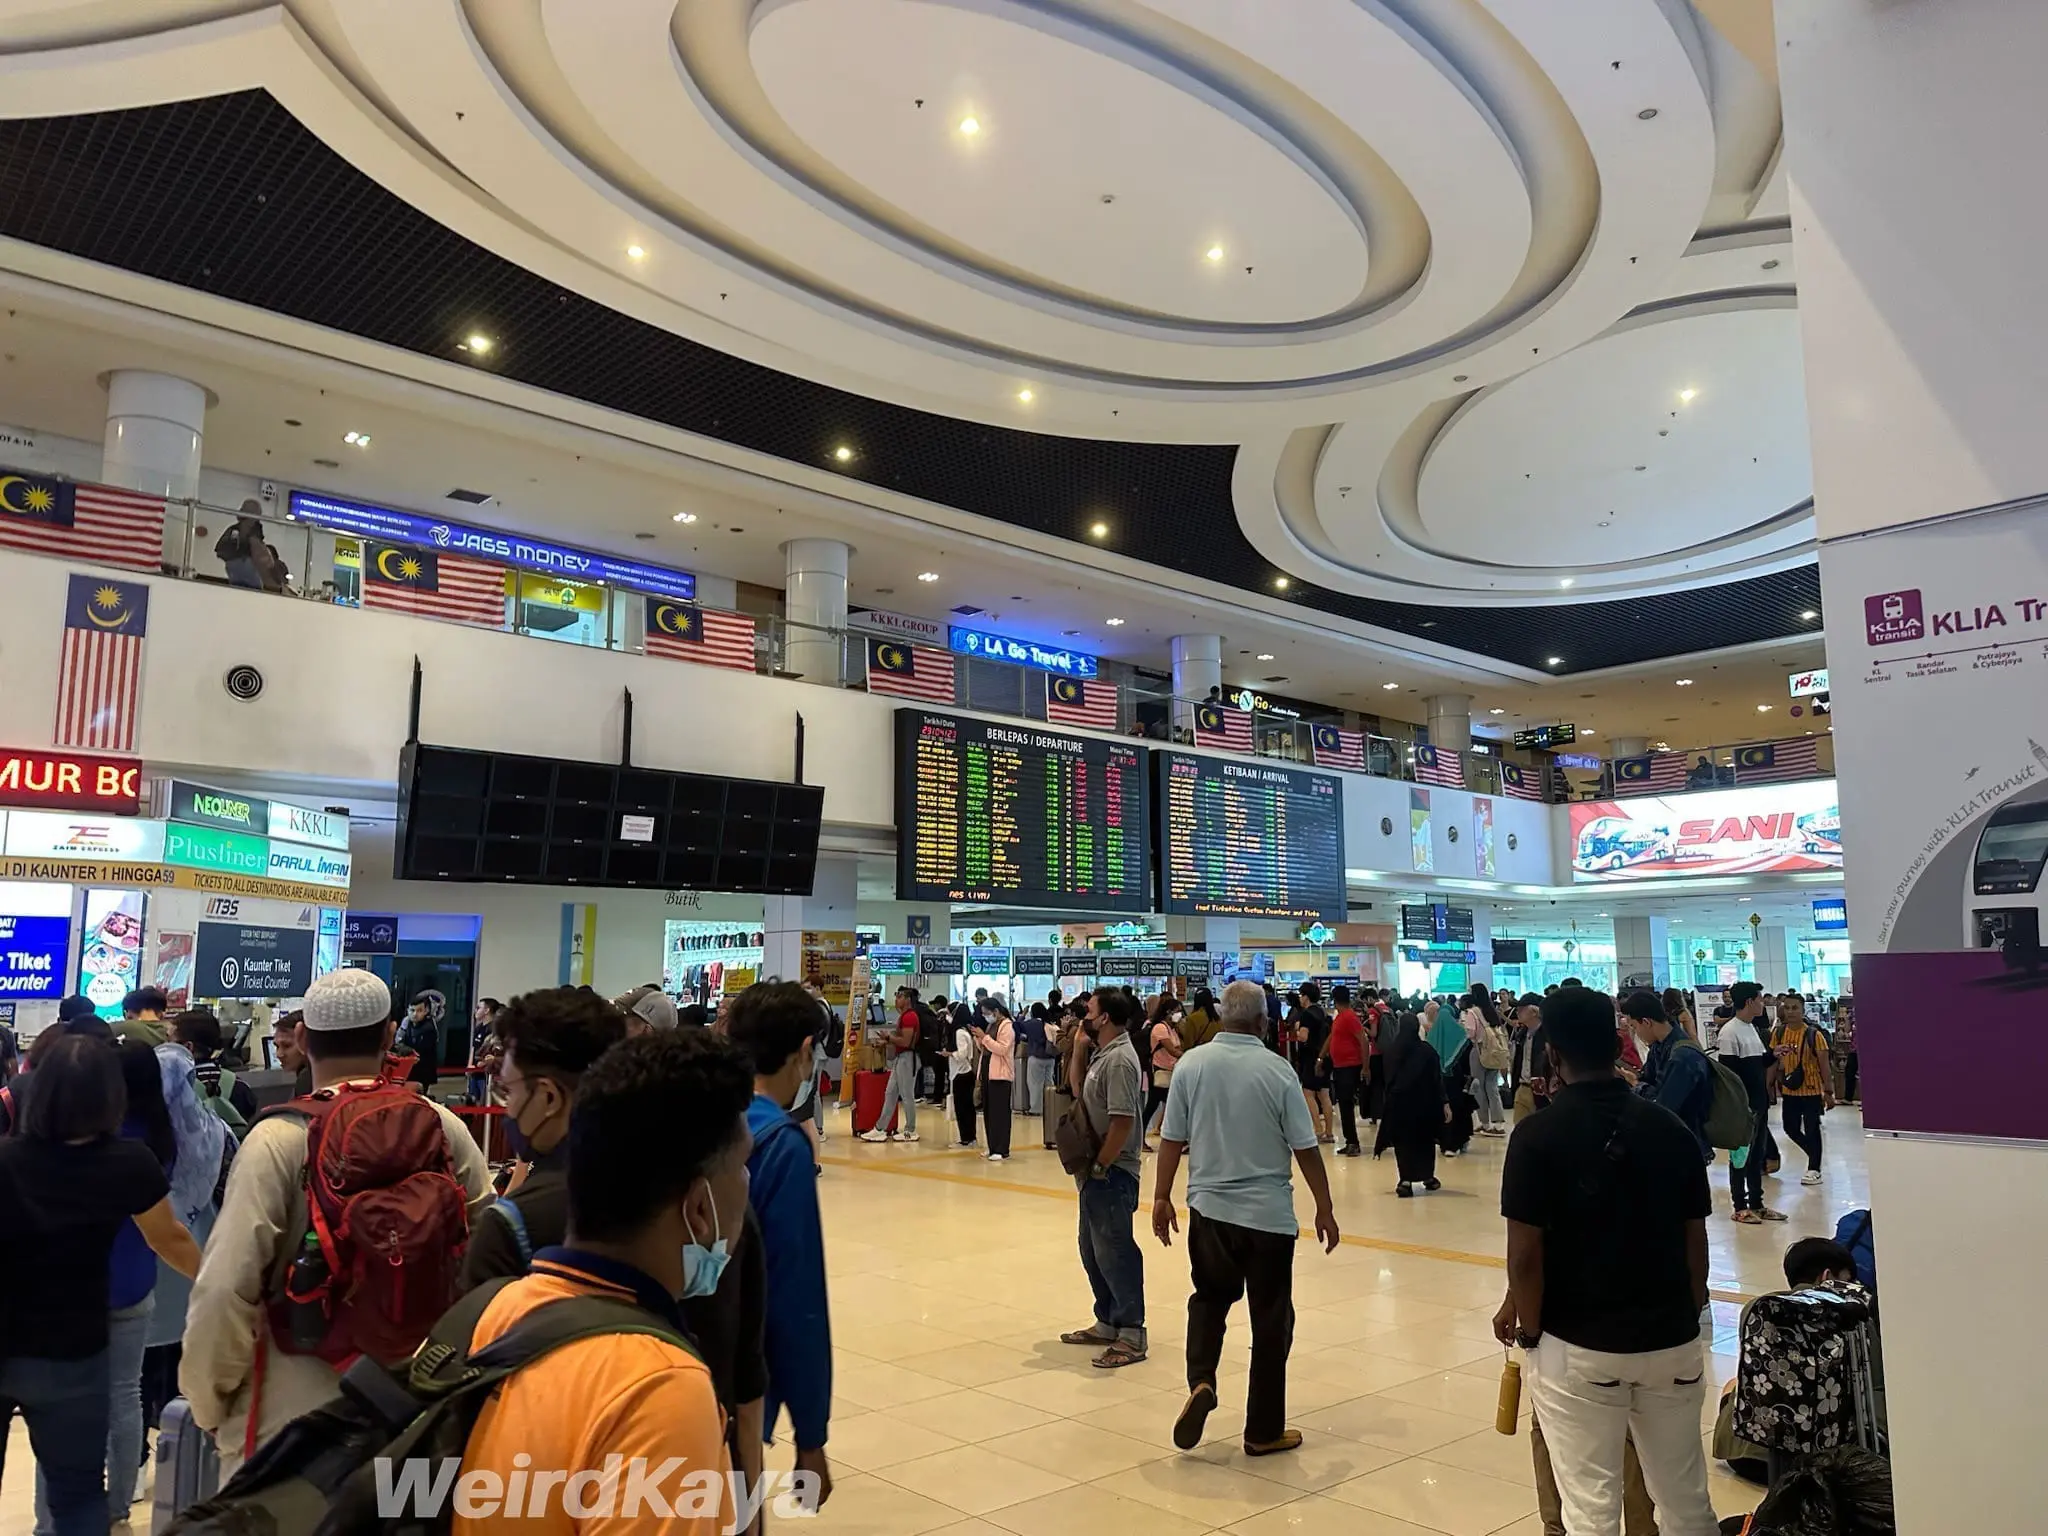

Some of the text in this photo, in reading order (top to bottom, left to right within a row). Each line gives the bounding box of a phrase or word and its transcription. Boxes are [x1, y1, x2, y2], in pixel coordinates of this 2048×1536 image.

[453, 533, 590, 572] JAGS MONEY
[902, 619, 938, 635] GROUP
[1870, 618, 1921, 634] KLIA
[1932, 604, 2007, 636] KLIA
[1875, 628, 1917, 642] transit
[984, 637, 1072, 670] LA Go Travel
[1977, 649, 2017, 662] Putrajaya
[1906, 665, 1958, 679] Tasik Selatan
[1916, 660, 1945, 669] Bandar
[1972, 656, 2023, 670] & Cyberjaya
[1863, 674, 1892, 684] Sentral
[1254, 695, 1269, 710] Go
[987, 727, 1084, 753] BERLEPAS / DEPARTURE
[1223, 765, 1257, 779] KETIBAAN
[1262, 771, 1289, 784] ARRIVAL
[194, 793, 250, 826] NEOLINER
[290, 809, 333, 838] KKKL
[1677, 812, 1795, 846] SANI
[169, 835, 267, 869] Plusliner
[1876, 764, 2035, 945] start your journey with KLIA Transit
[270, 853, 315, 872] DARUL
[13, 863, 26, 876] DI
[31, 863, 96, 880] KAUNTER
[101, 867, 107, 880] 1
[112, 867, 162, 882] HINGGA
[163, 870, 175, 884] 59
[194, 873, 222, 889] TICKETS
[224, 877, 233, 890] TO
[233, 879, 245, 892] ALL
[246, 880, 291, 897] DESTINATIONS
[291, 885, 303, 898] ARE
[303, 886, 332, 901] AVAILABLE
[332, 889, 340, 902] AT
[664, 892, 702, 910] Butik
[1436, 917, 1447, 930] L3
[7, 952, 51, 970] Tiket
[243, 958, 291, 972] Kaunter Tiket
[226, 964, 234, 983] 18
[243, 975, 291, 989] Ticket Counter
